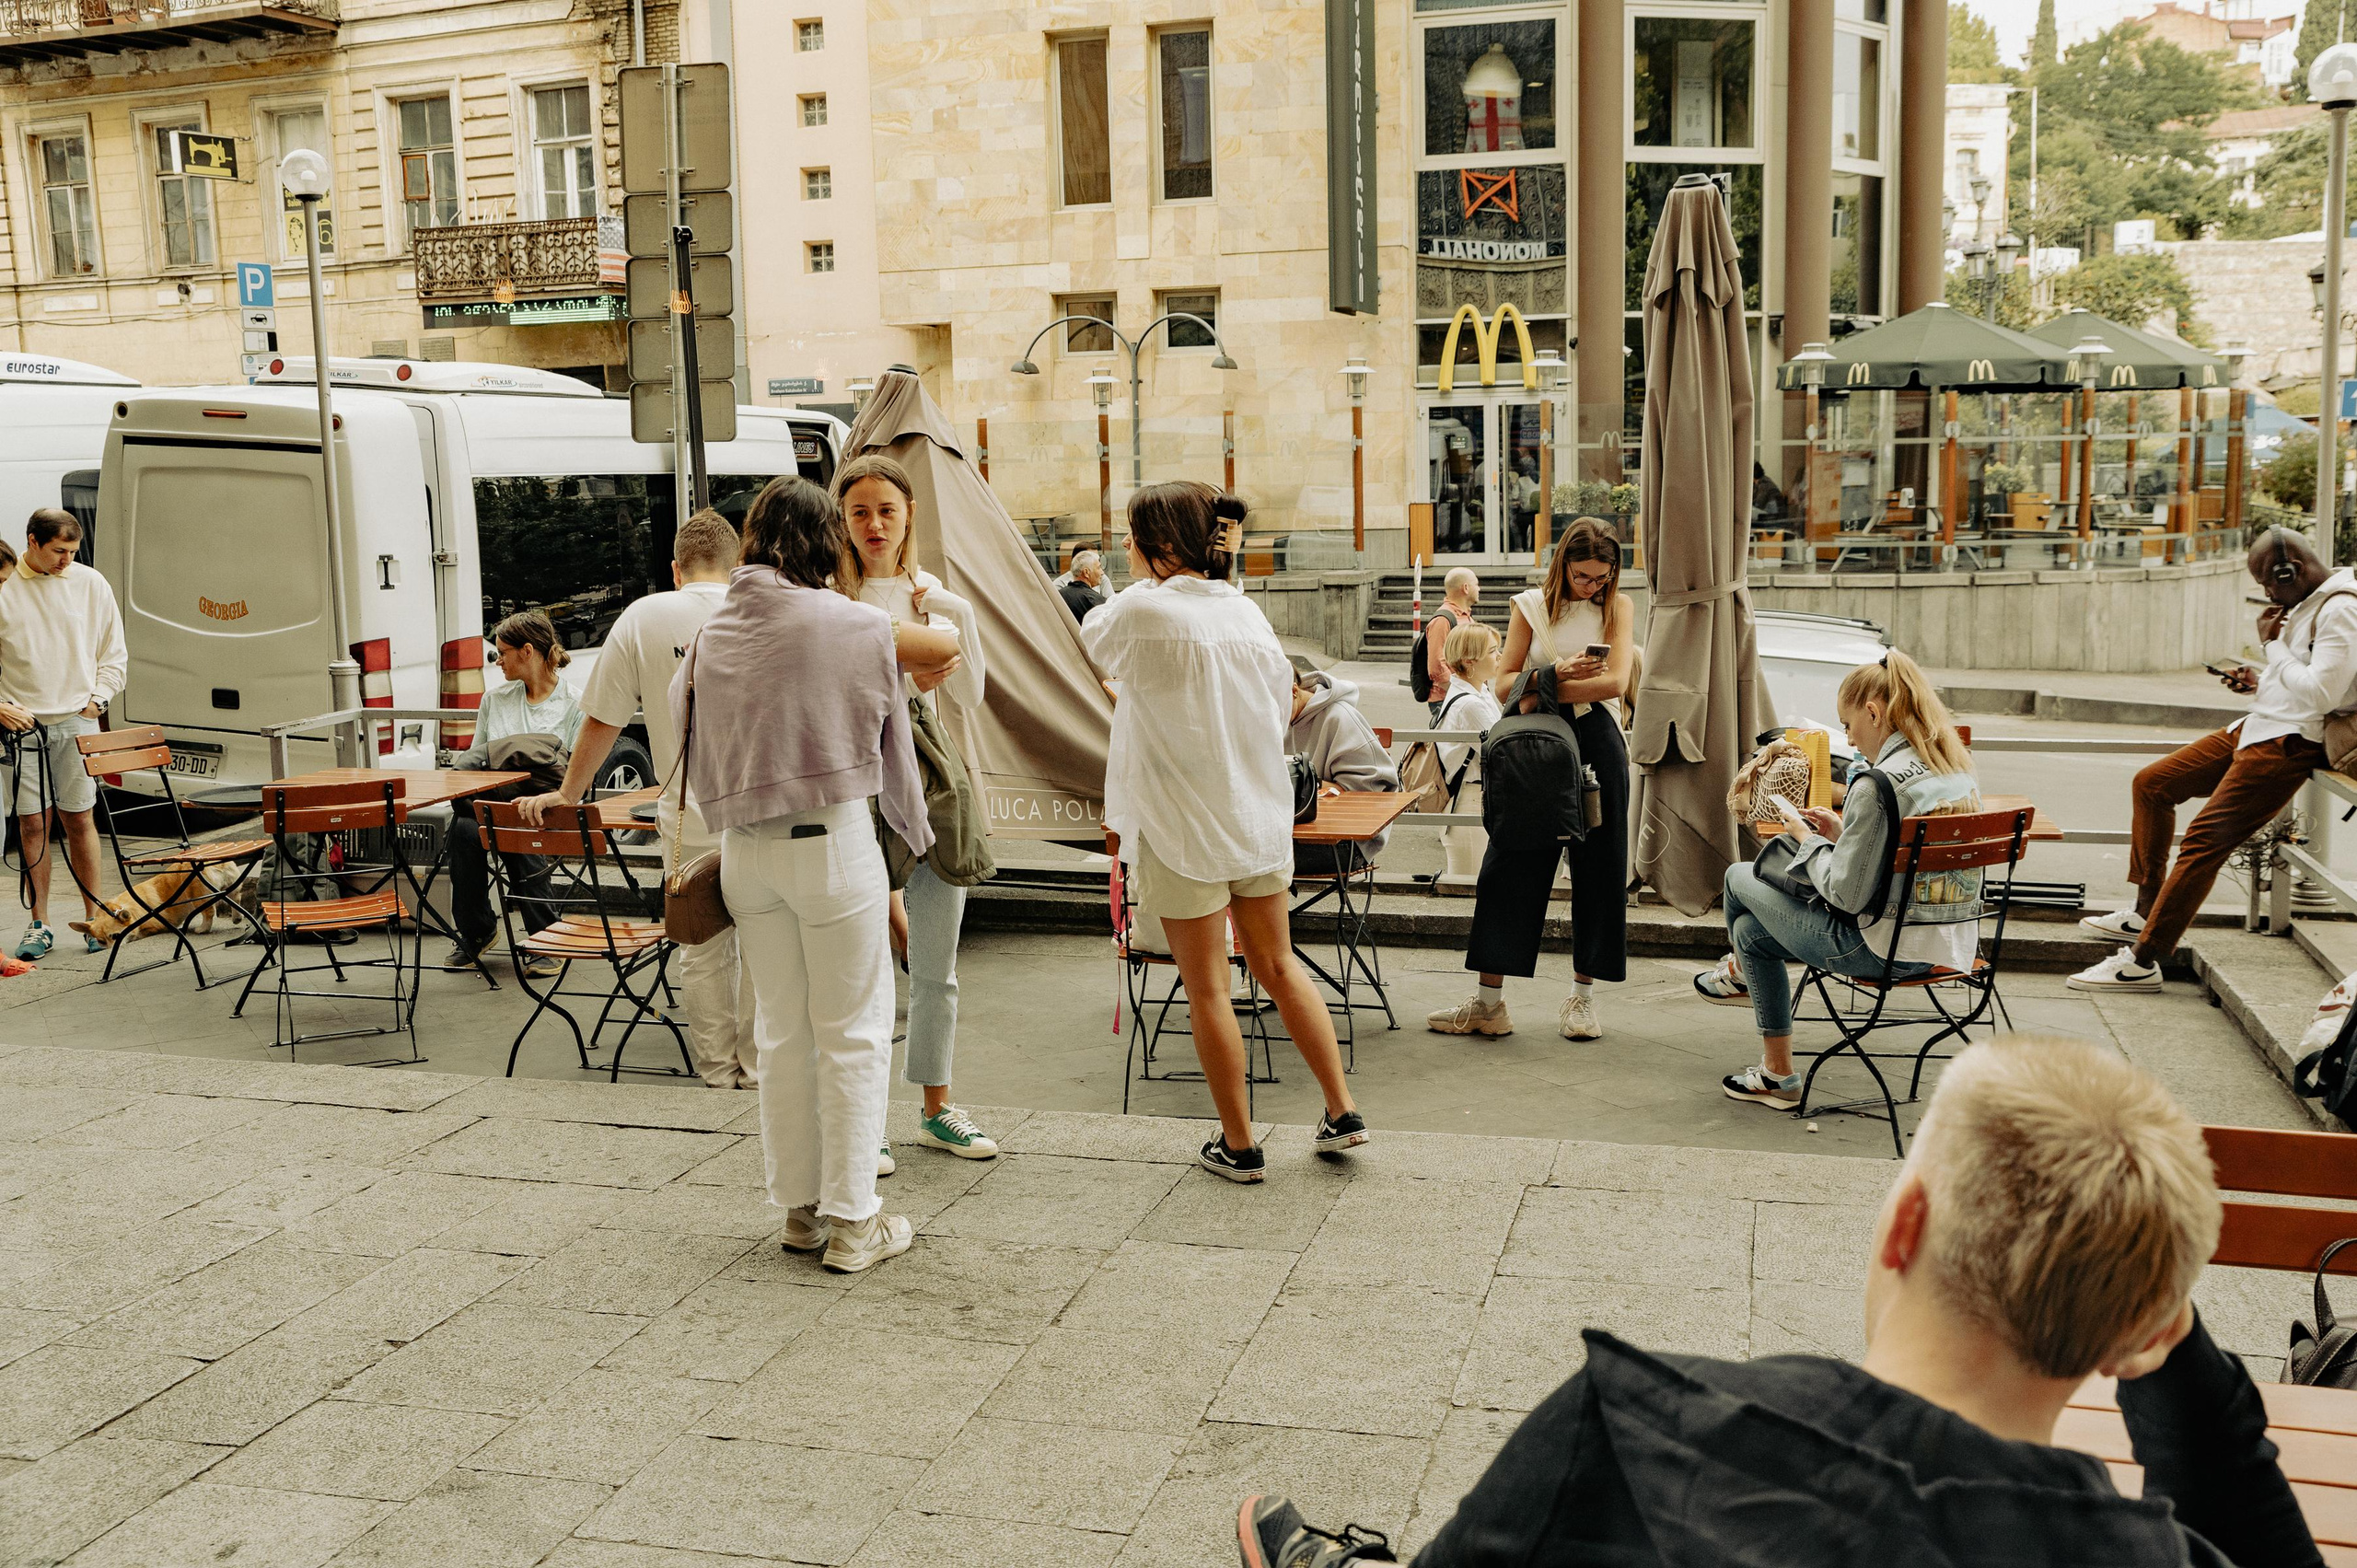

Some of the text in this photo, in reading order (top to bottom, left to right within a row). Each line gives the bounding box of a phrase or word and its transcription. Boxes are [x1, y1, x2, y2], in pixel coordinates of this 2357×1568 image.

[245, 267, 265, 302] P
[199, 596, 250, 621] GEORGIA
[991, 796, 1043, 820] LUCA
